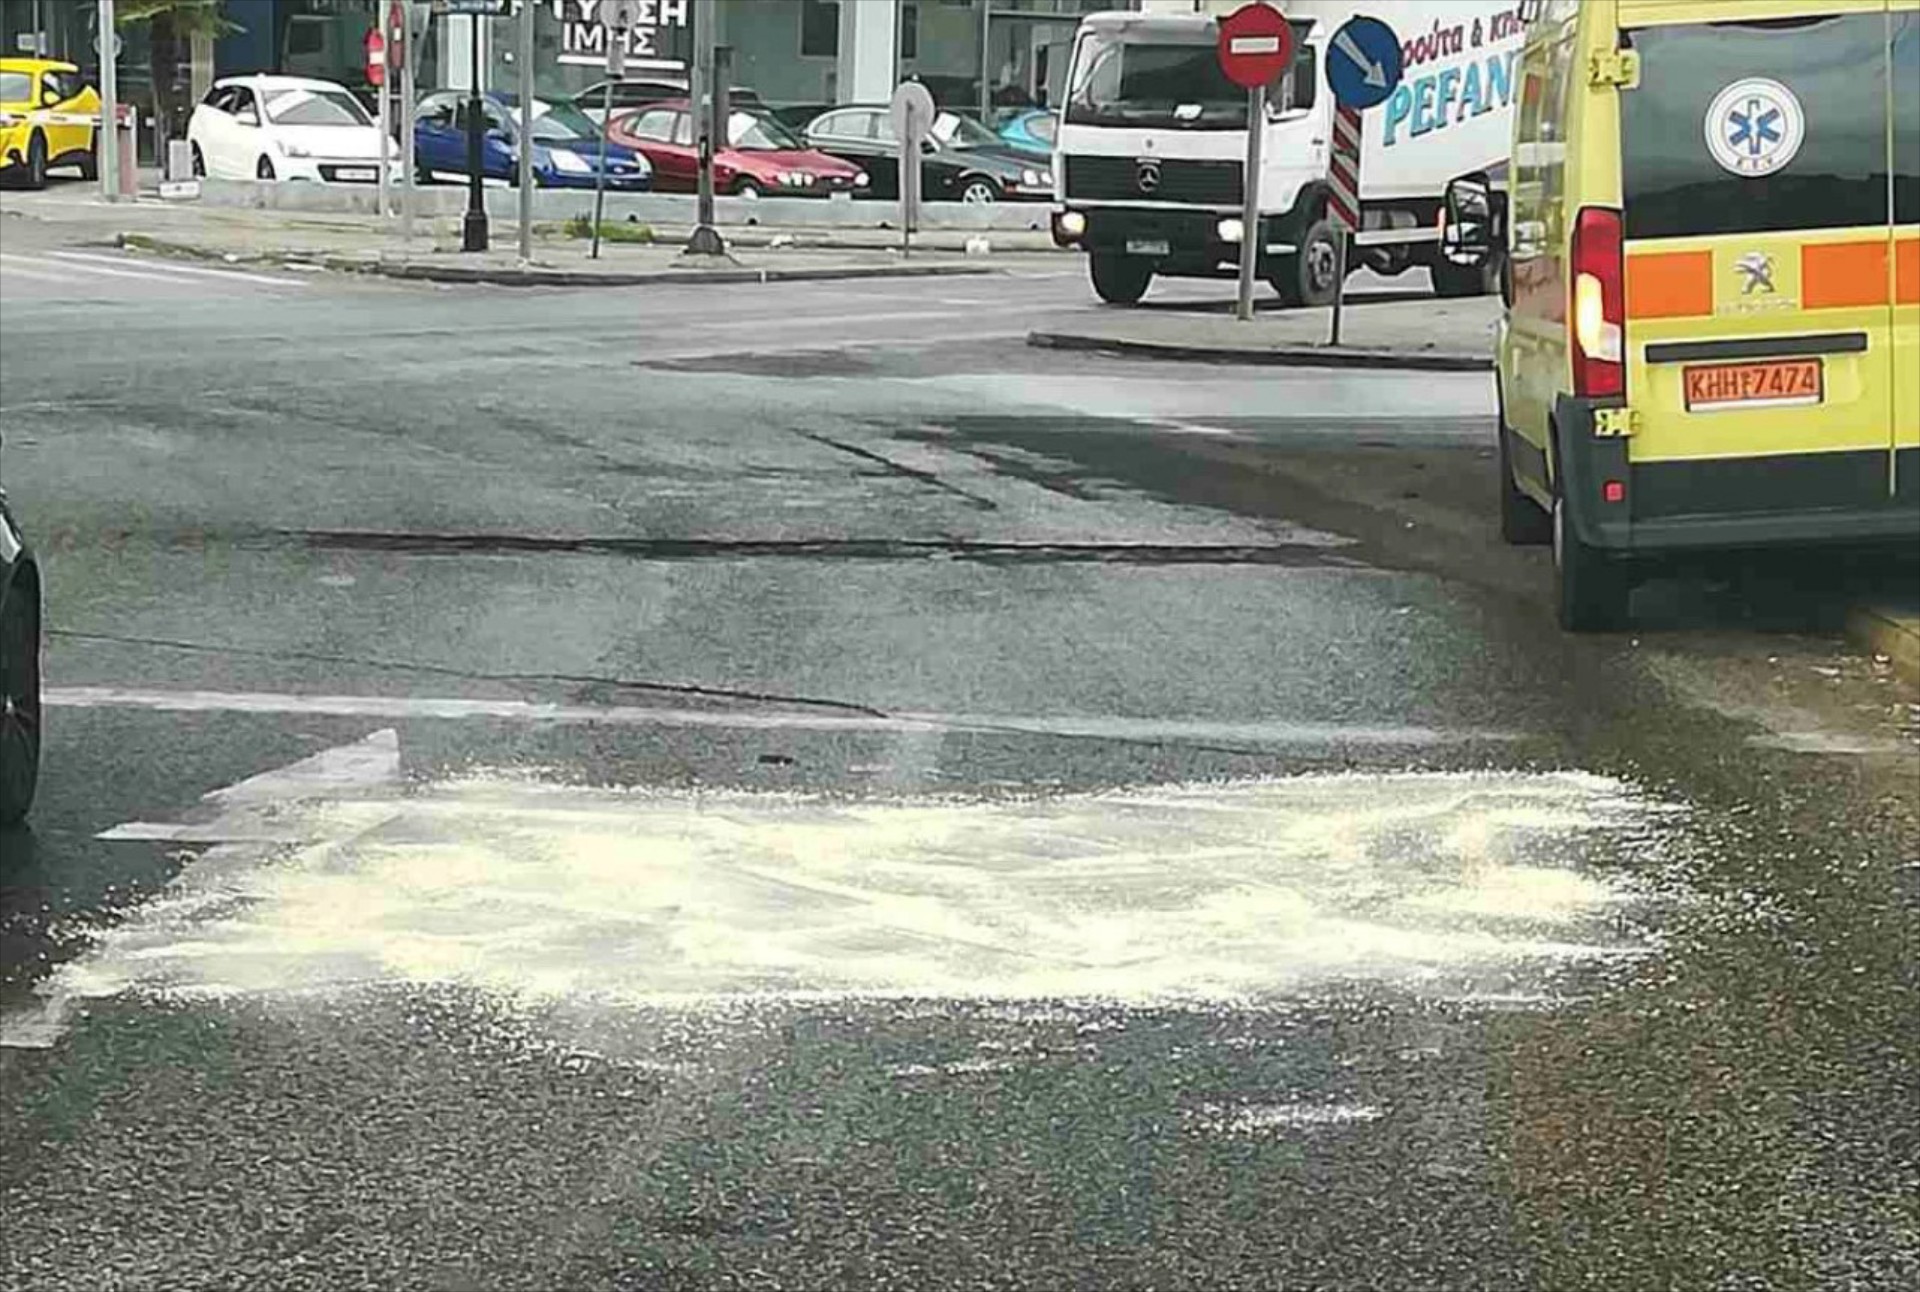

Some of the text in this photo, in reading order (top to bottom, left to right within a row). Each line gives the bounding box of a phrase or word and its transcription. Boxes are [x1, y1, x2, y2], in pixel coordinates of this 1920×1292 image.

[1402, 18, 1464, 69] ρούτα
[1470, 17, 1483, 48] &
[1382, 50, 1516, 147] PEFAN
